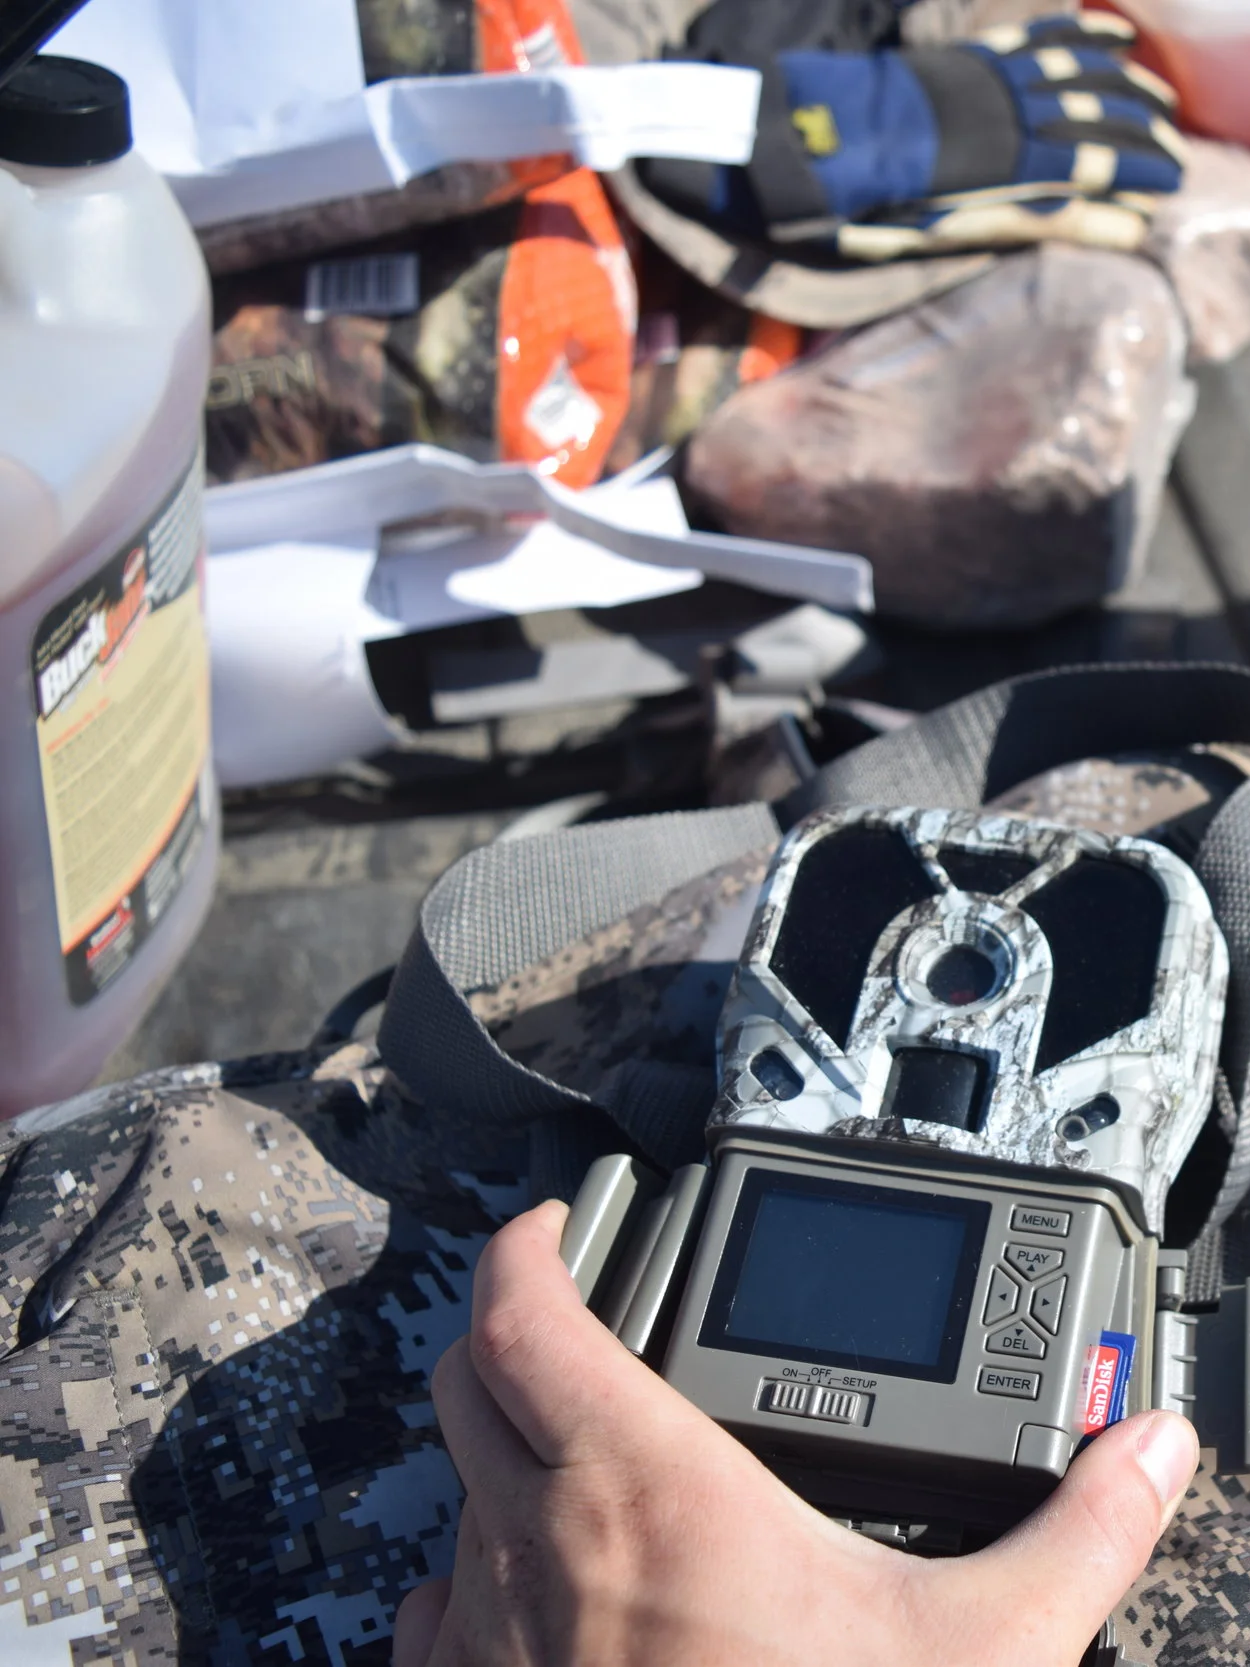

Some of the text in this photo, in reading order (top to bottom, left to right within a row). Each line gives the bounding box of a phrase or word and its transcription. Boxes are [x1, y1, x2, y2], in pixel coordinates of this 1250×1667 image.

[1021, 1213, 1060, 1229] MENU
[1016, 1250, 1050, 1264] PLAY
[1002, 1336, 1029, 1351] DEL
[782, 1367, 877, 1389] ON OFF SETUP
[986, 1373, 1031, 1391] ENTER
[1088, 1359, 1115, 1426] SanDisk
